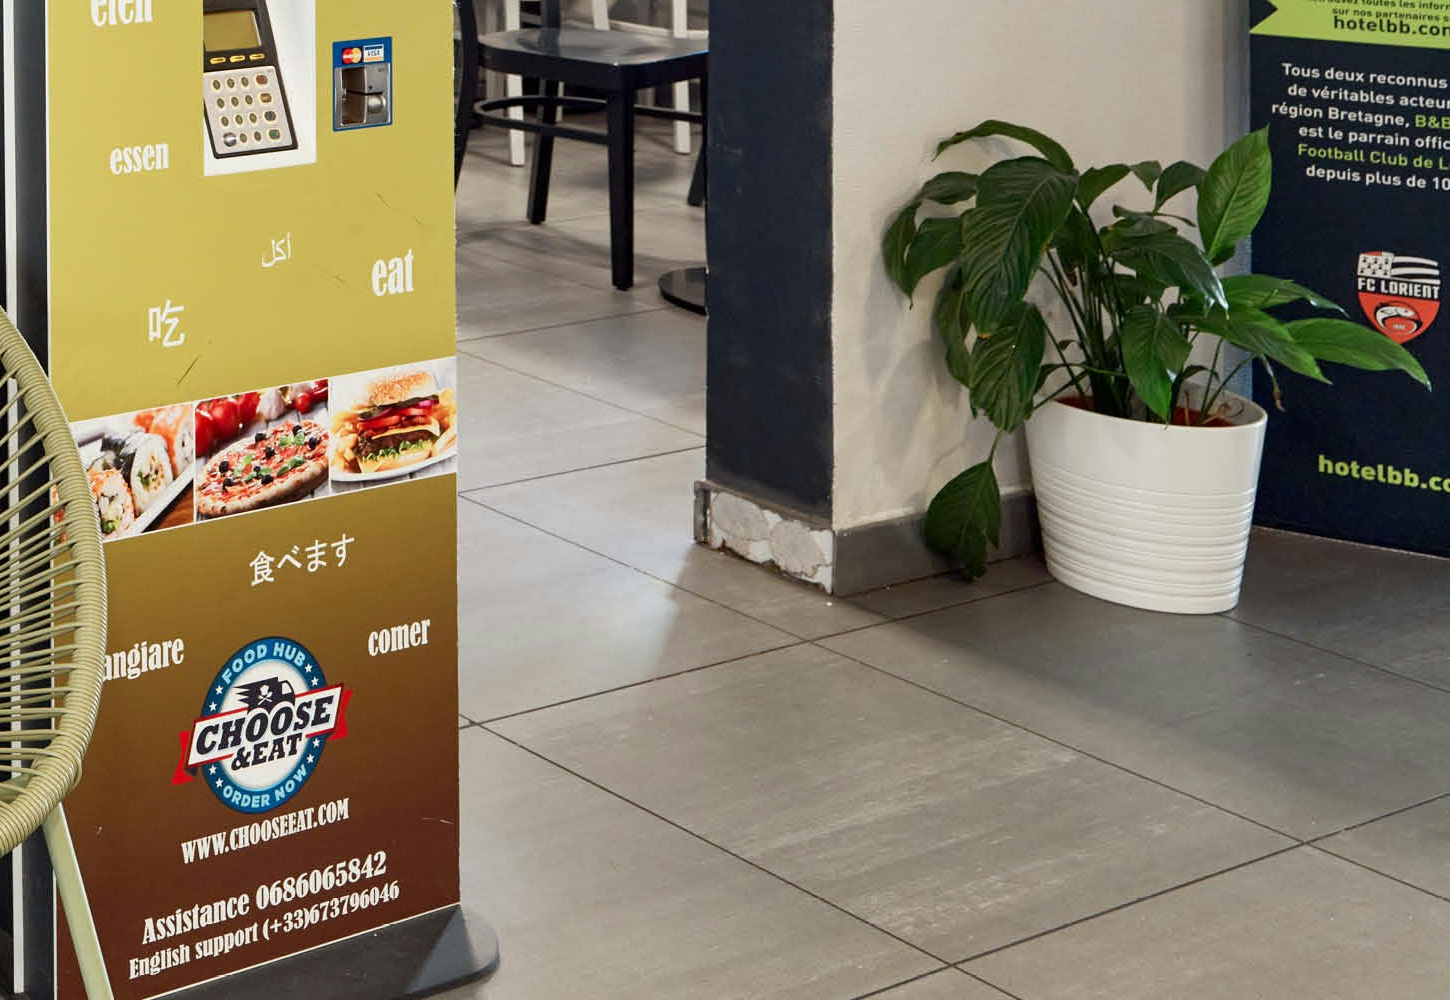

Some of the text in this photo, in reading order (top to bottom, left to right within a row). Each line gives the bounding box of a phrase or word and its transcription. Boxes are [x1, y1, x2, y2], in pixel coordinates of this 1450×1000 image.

[1332, 7, 1349, 16] sur
[1353, 8, 1373, 17] nos
[1375, 10, 1441, 22] partenaires
[1399, 0, 1416, 9] les
[1281, 63, 1448, 89] Tous deux reconnus
[1287, 84, 1307, 97] de
[1312, 86, 1395, 105] véritables
[1271, 103, 1323, 118] région
[1328, 107, 1410, 128] Bretagne,
[1297, 143, 1365, 163] Football
[1370, 151, 1408, 167] Club
[1413, 154, 1433, 169] de
[1299, 127, 1324, 139] est
[1328, 127, 1343, 140] le
[1349, 130, 1410, 148] parrain
[109, 142, 170, 176] essen
[1306, 164, 1361, 182] depuis
[1365, 171, 1402, 187] plus
[1406, 174, 1427, 189] de
[261, 231, 292, 268] أكل
[371, 248, 415, 297] eat
[1358, 277, 1440, 299] FC LORIENT
[148, 299, 186, 348] 吃
[249, 533, 355, 587] 食べます
[367, 617, 431, 657] comer
[103, 638, 184, 682] angiare
[220, 642, 307, 685] FOOD HUB
[195, 693, 336, 755] CHOOSE
[230, 733, 304, 771] &EAT
[222, 764, 309, 809] ORDER NOW
[180, 797, 350, 864] WWW.CHOOSEEAT.COM
[142, 850, 387, 944] Assistance 0686065842
[129, 880, 400, 980] English support (+33)673796046
